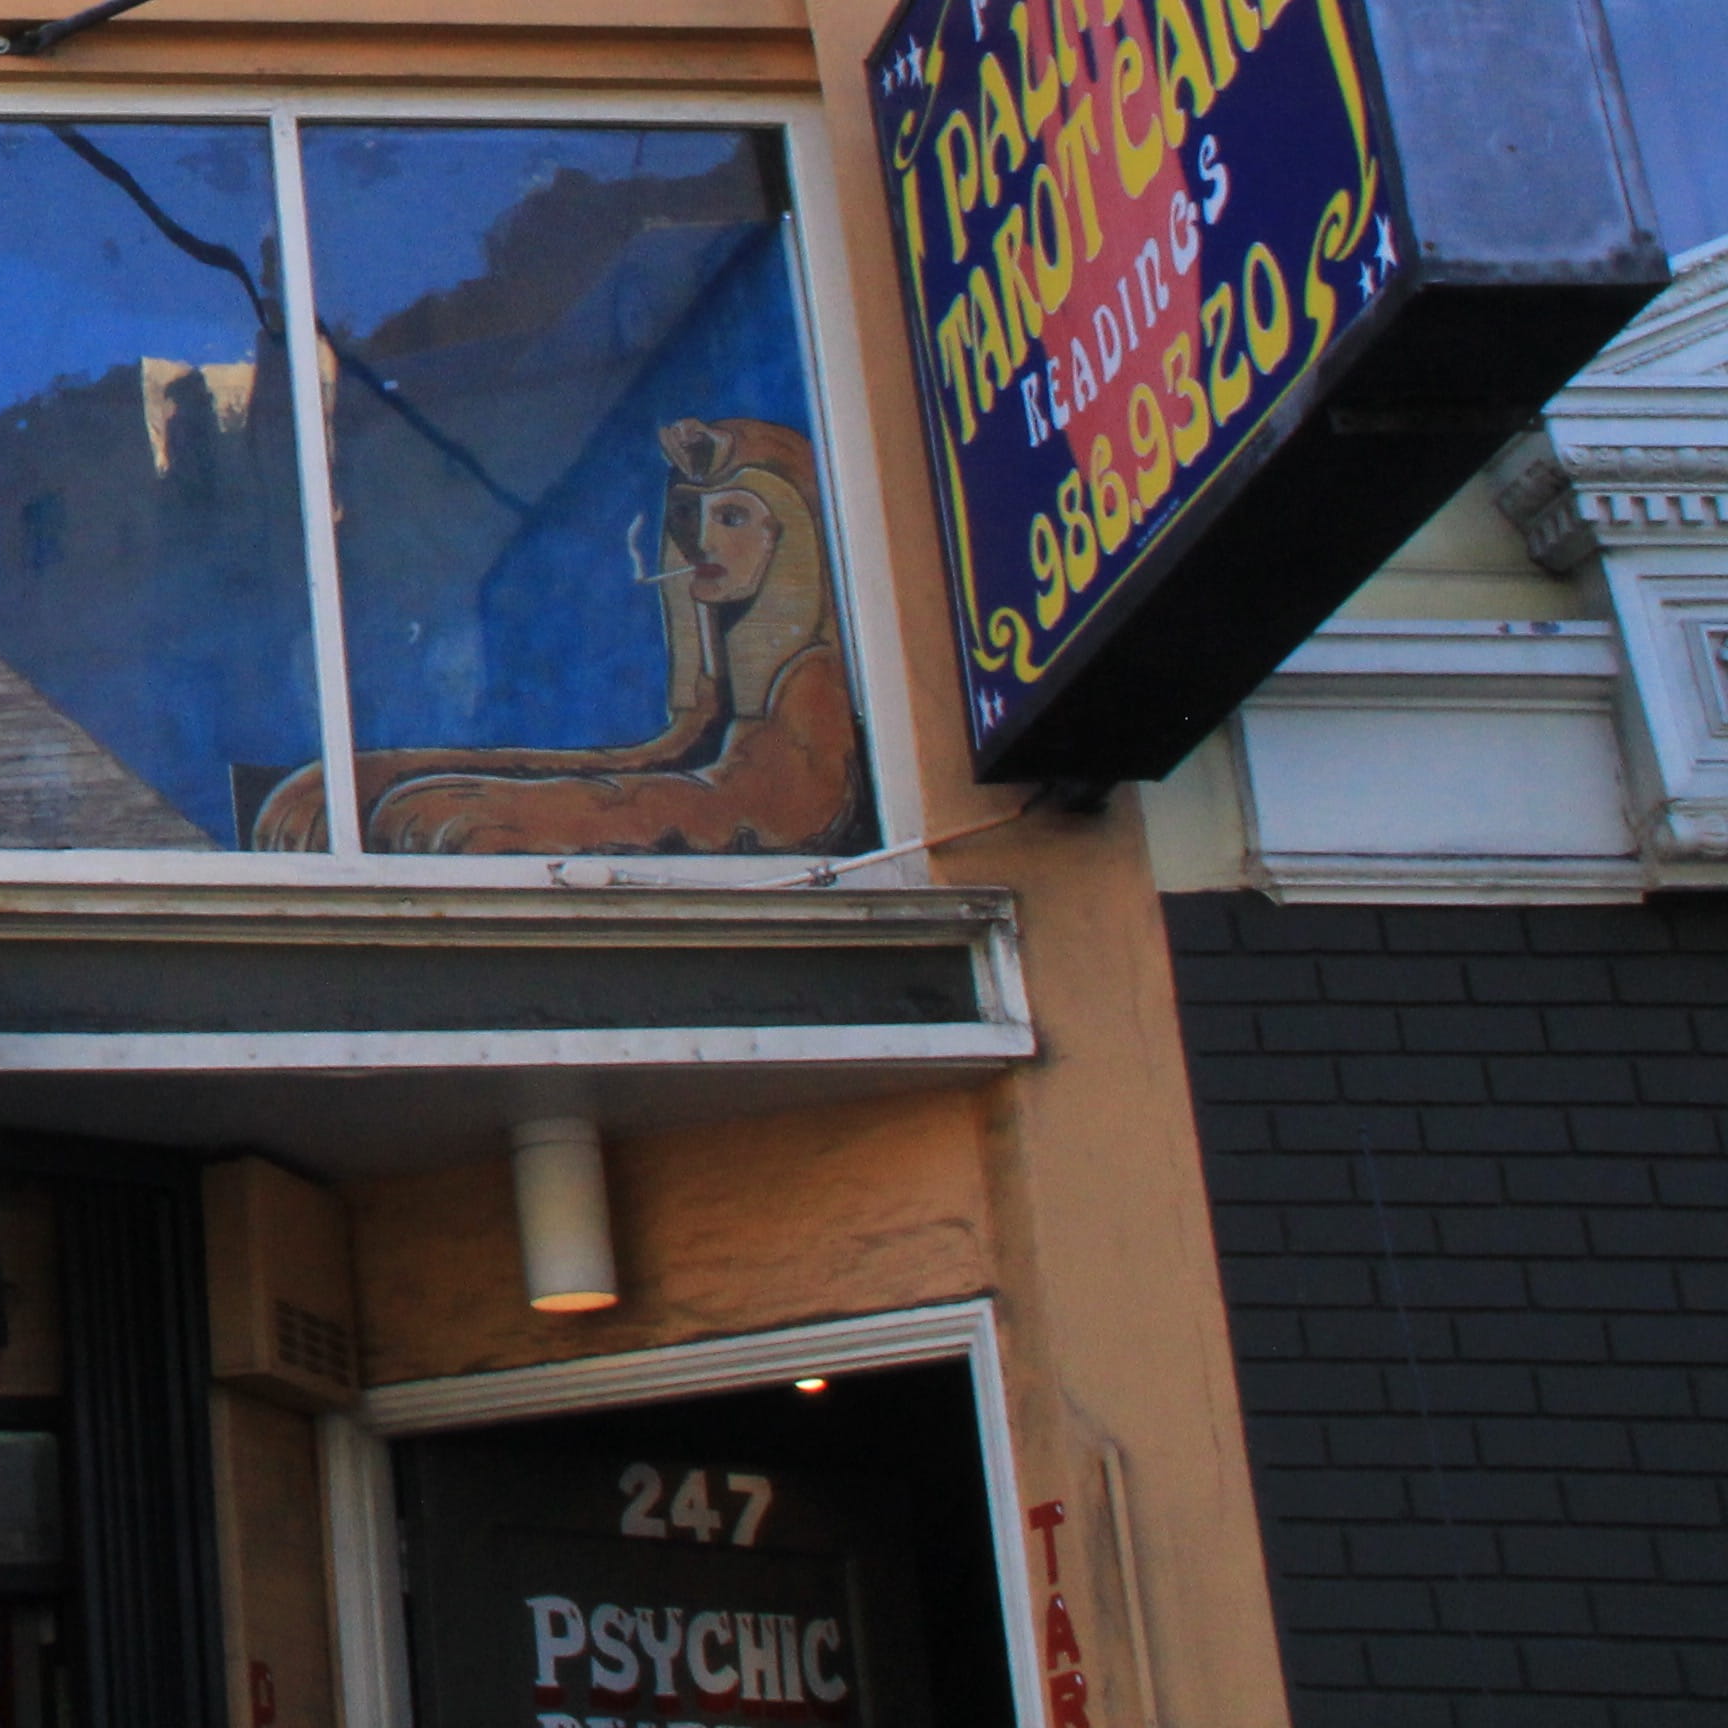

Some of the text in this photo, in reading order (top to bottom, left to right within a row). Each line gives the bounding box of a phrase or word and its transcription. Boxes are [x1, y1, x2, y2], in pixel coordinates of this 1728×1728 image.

[935, 114, 1100, 444] TAROT
[1019, 133, 1230, 449] READINGS
[1027, 241, 1292, 630] 986.9320
[527, 1596, 849, 1704] PSYCHIC
[618, 1464, 773, 1546] 247
